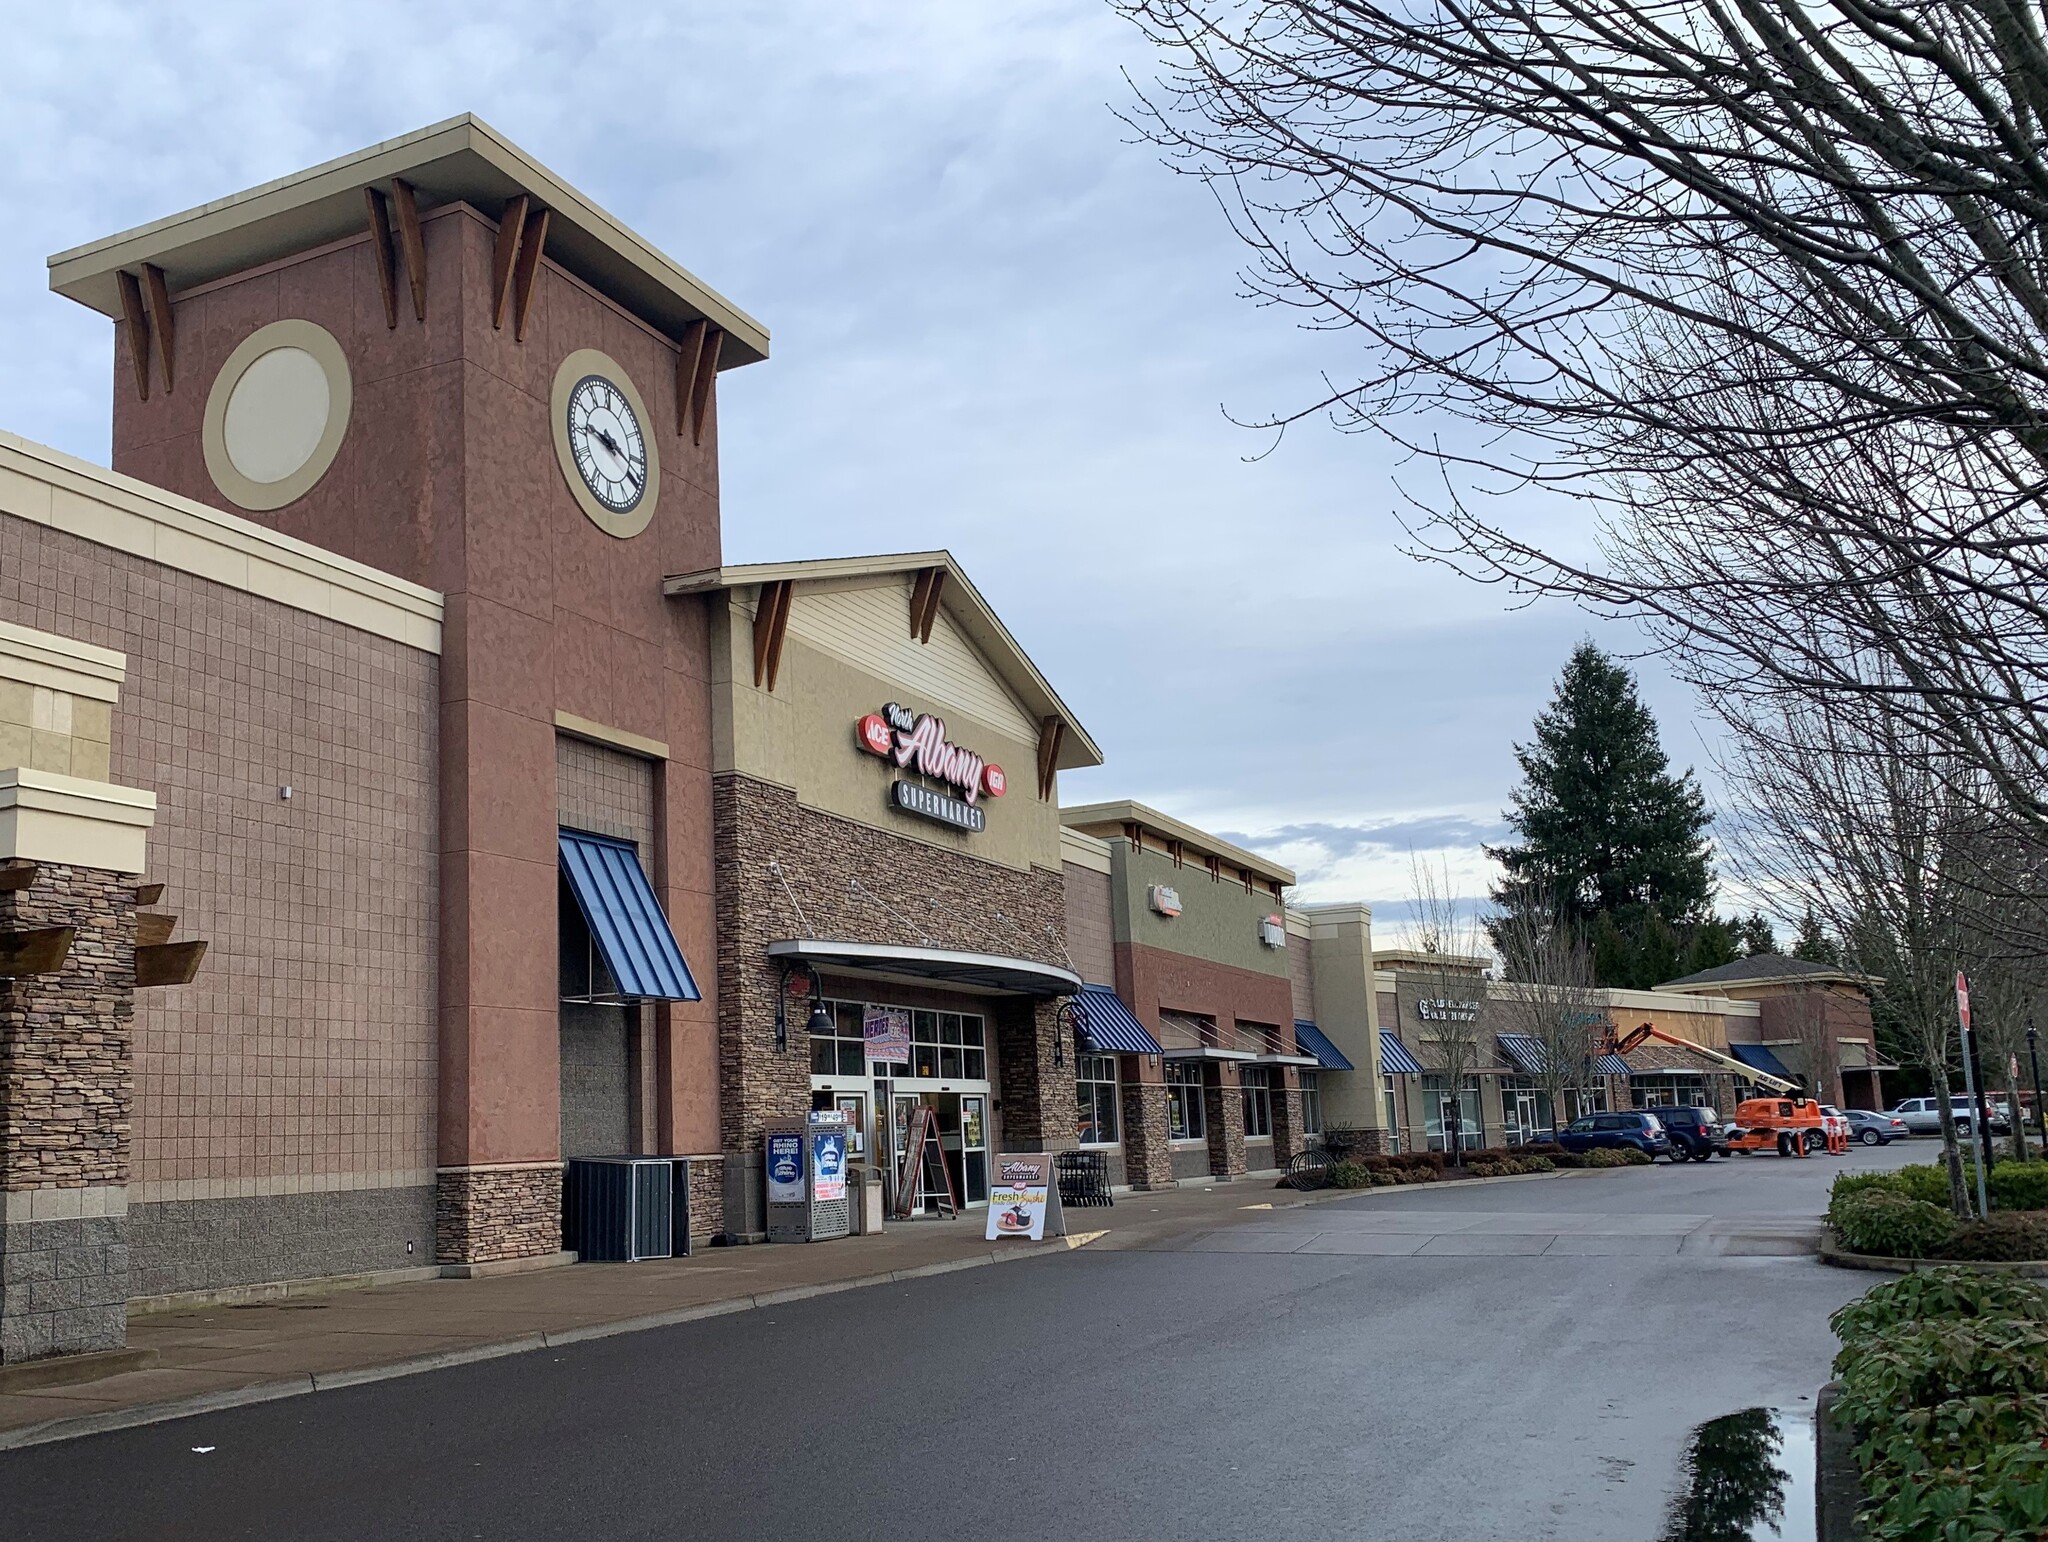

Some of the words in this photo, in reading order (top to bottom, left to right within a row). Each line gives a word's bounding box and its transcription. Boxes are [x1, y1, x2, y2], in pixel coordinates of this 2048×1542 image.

[889, 703, 914, 731] North
[867, 719, 889, 745] ACE
[895, 713, 984, 807] Albany
[903, 784, 982, 829] SUPERMARKET
[1757, 1074, 1769, 1082] JLG
[1769, 1079, 1783, 1088] LIFT
[1002, 1161, 1040, 1175] Albany
[992, 1191, 1019, 1201] Fresh
[1019, 1190, 1045, 1207] Sushi
